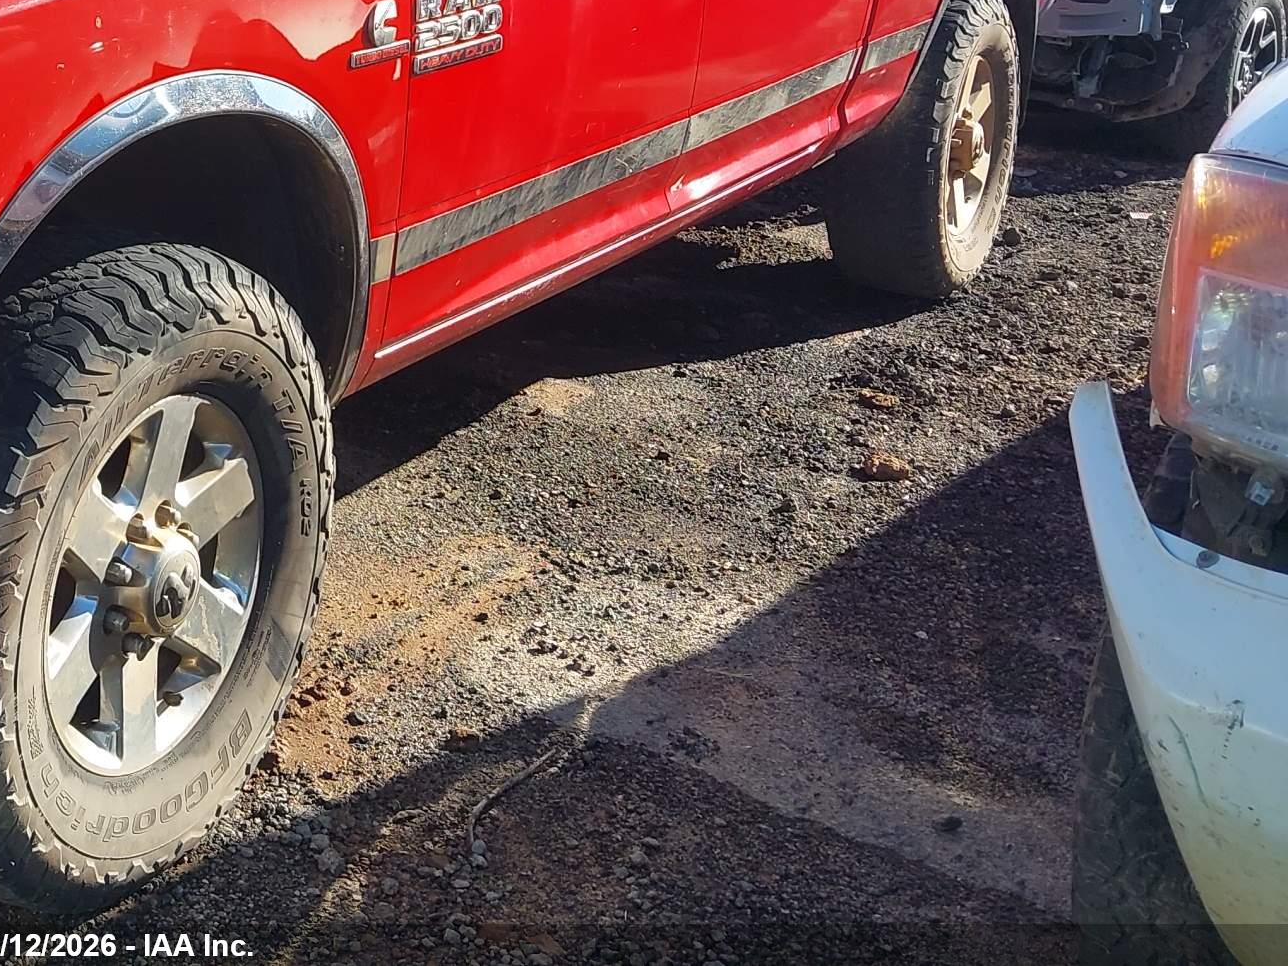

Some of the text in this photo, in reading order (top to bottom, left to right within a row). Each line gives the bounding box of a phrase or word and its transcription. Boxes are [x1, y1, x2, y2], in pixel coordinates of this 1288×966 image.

[414, 3, 503, 53] 2500
[420, 39, 501, 70] HEAVY DUTY
[40, 708, 253, 842] BFGoodrich
